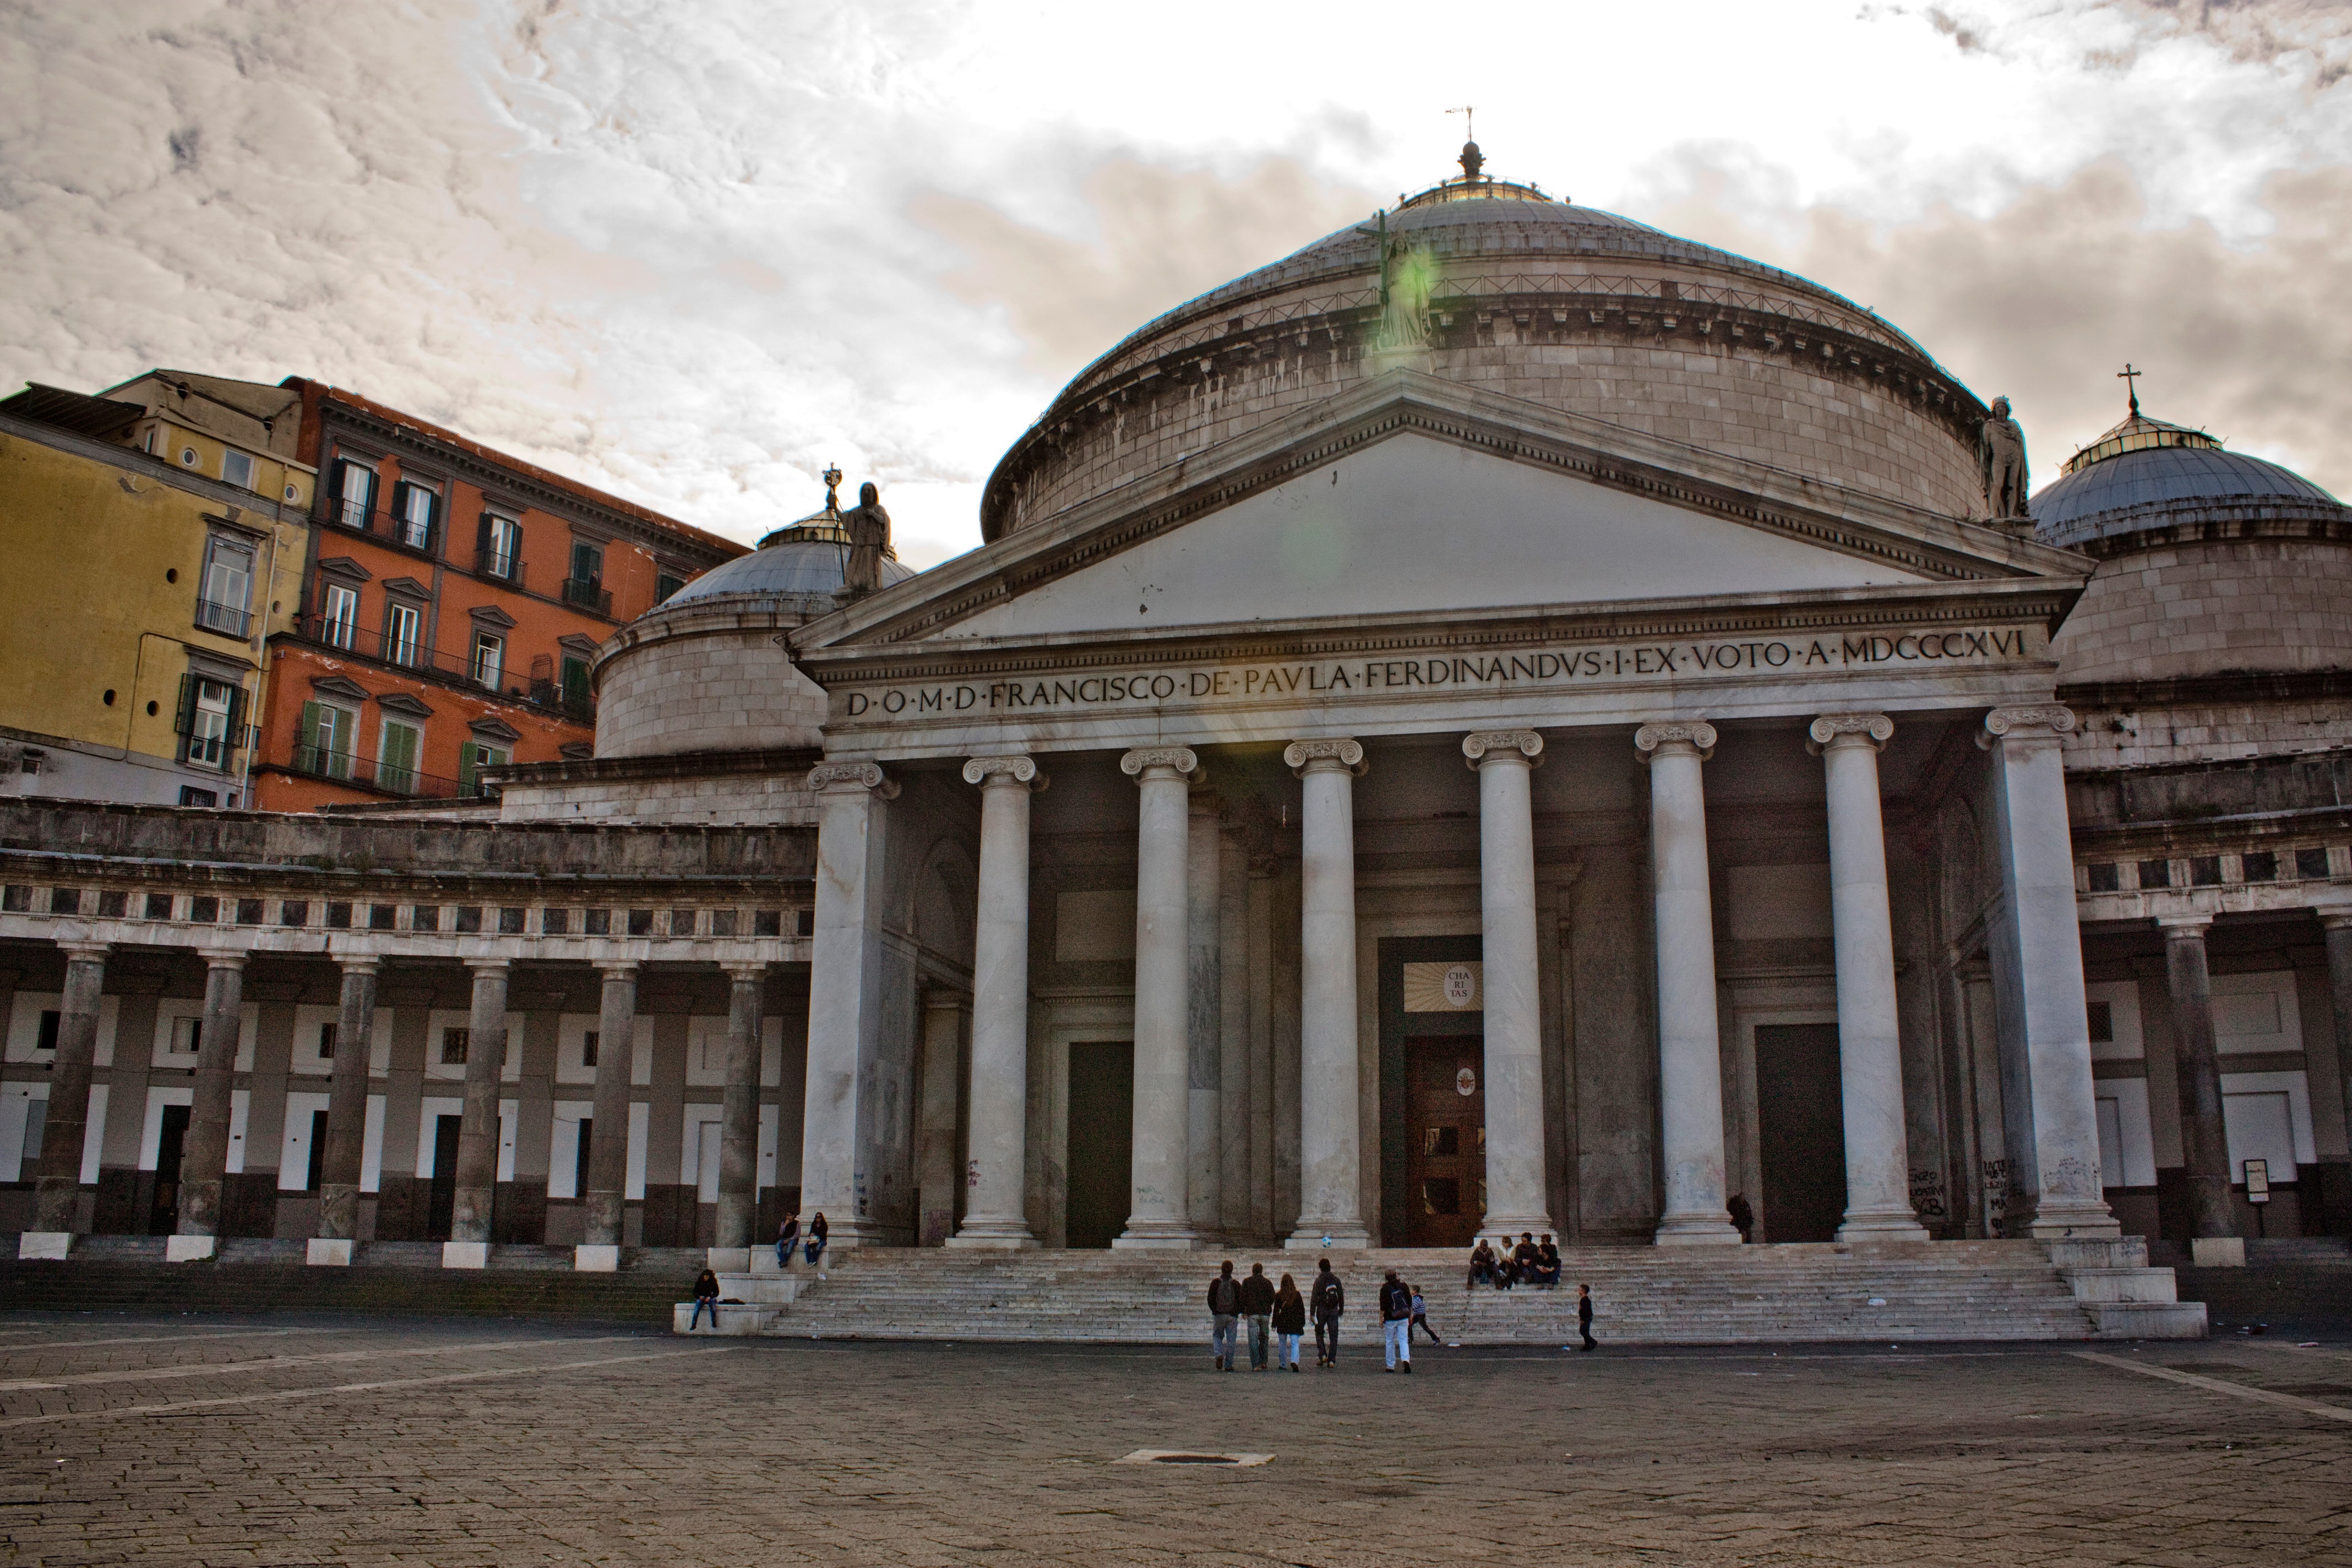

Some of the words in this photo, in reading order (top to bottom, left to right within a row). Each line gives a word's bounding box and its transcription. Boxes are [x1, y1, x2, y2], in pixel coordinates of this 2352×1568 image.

[990, 675, 1174, 707] FRANCISCO
[1190, 672, 1229, 696] DE
[1245, 665, 1350, 694] PAVLA
[1366, 651, 1601, 687] FERDINANDVS
[1635, 647, 1677, 673] EX
[1692, 642, 1790, 669] VOTO
[1843, 630, 2024, 663] MDCCCXVI
